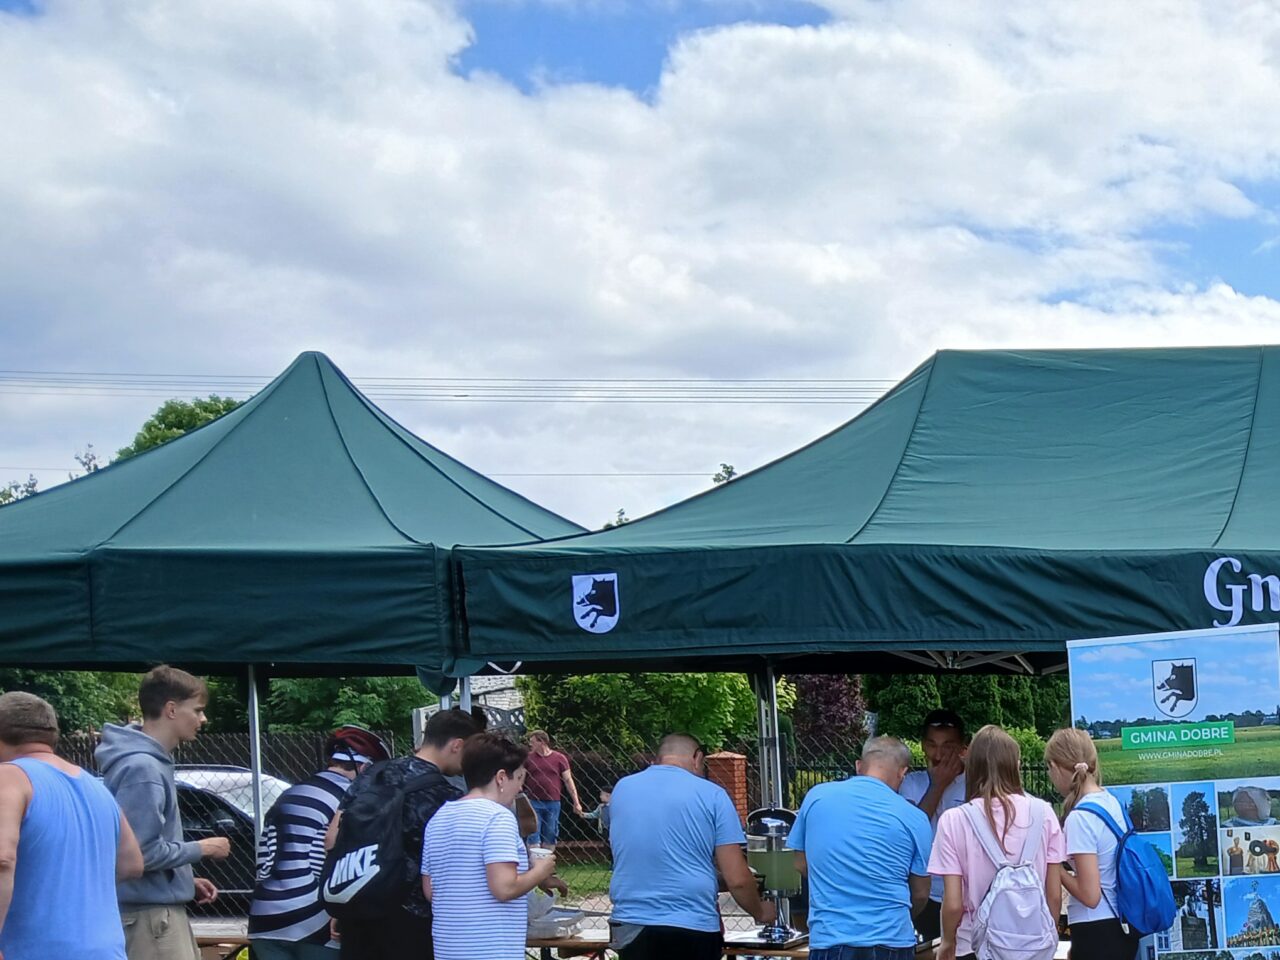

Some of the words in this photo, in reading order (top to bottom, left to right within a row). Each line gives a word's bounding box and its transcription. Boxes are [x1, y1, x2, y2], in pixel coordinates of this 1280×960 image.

[1130, 727, 1178, 745] GMINA
[1180, 726, 1230, 742] DOBRE
[1138, 748, 1224, 760] WWW.GMINADOBRE.PL
[330, 843, 379, 888] NIKE
